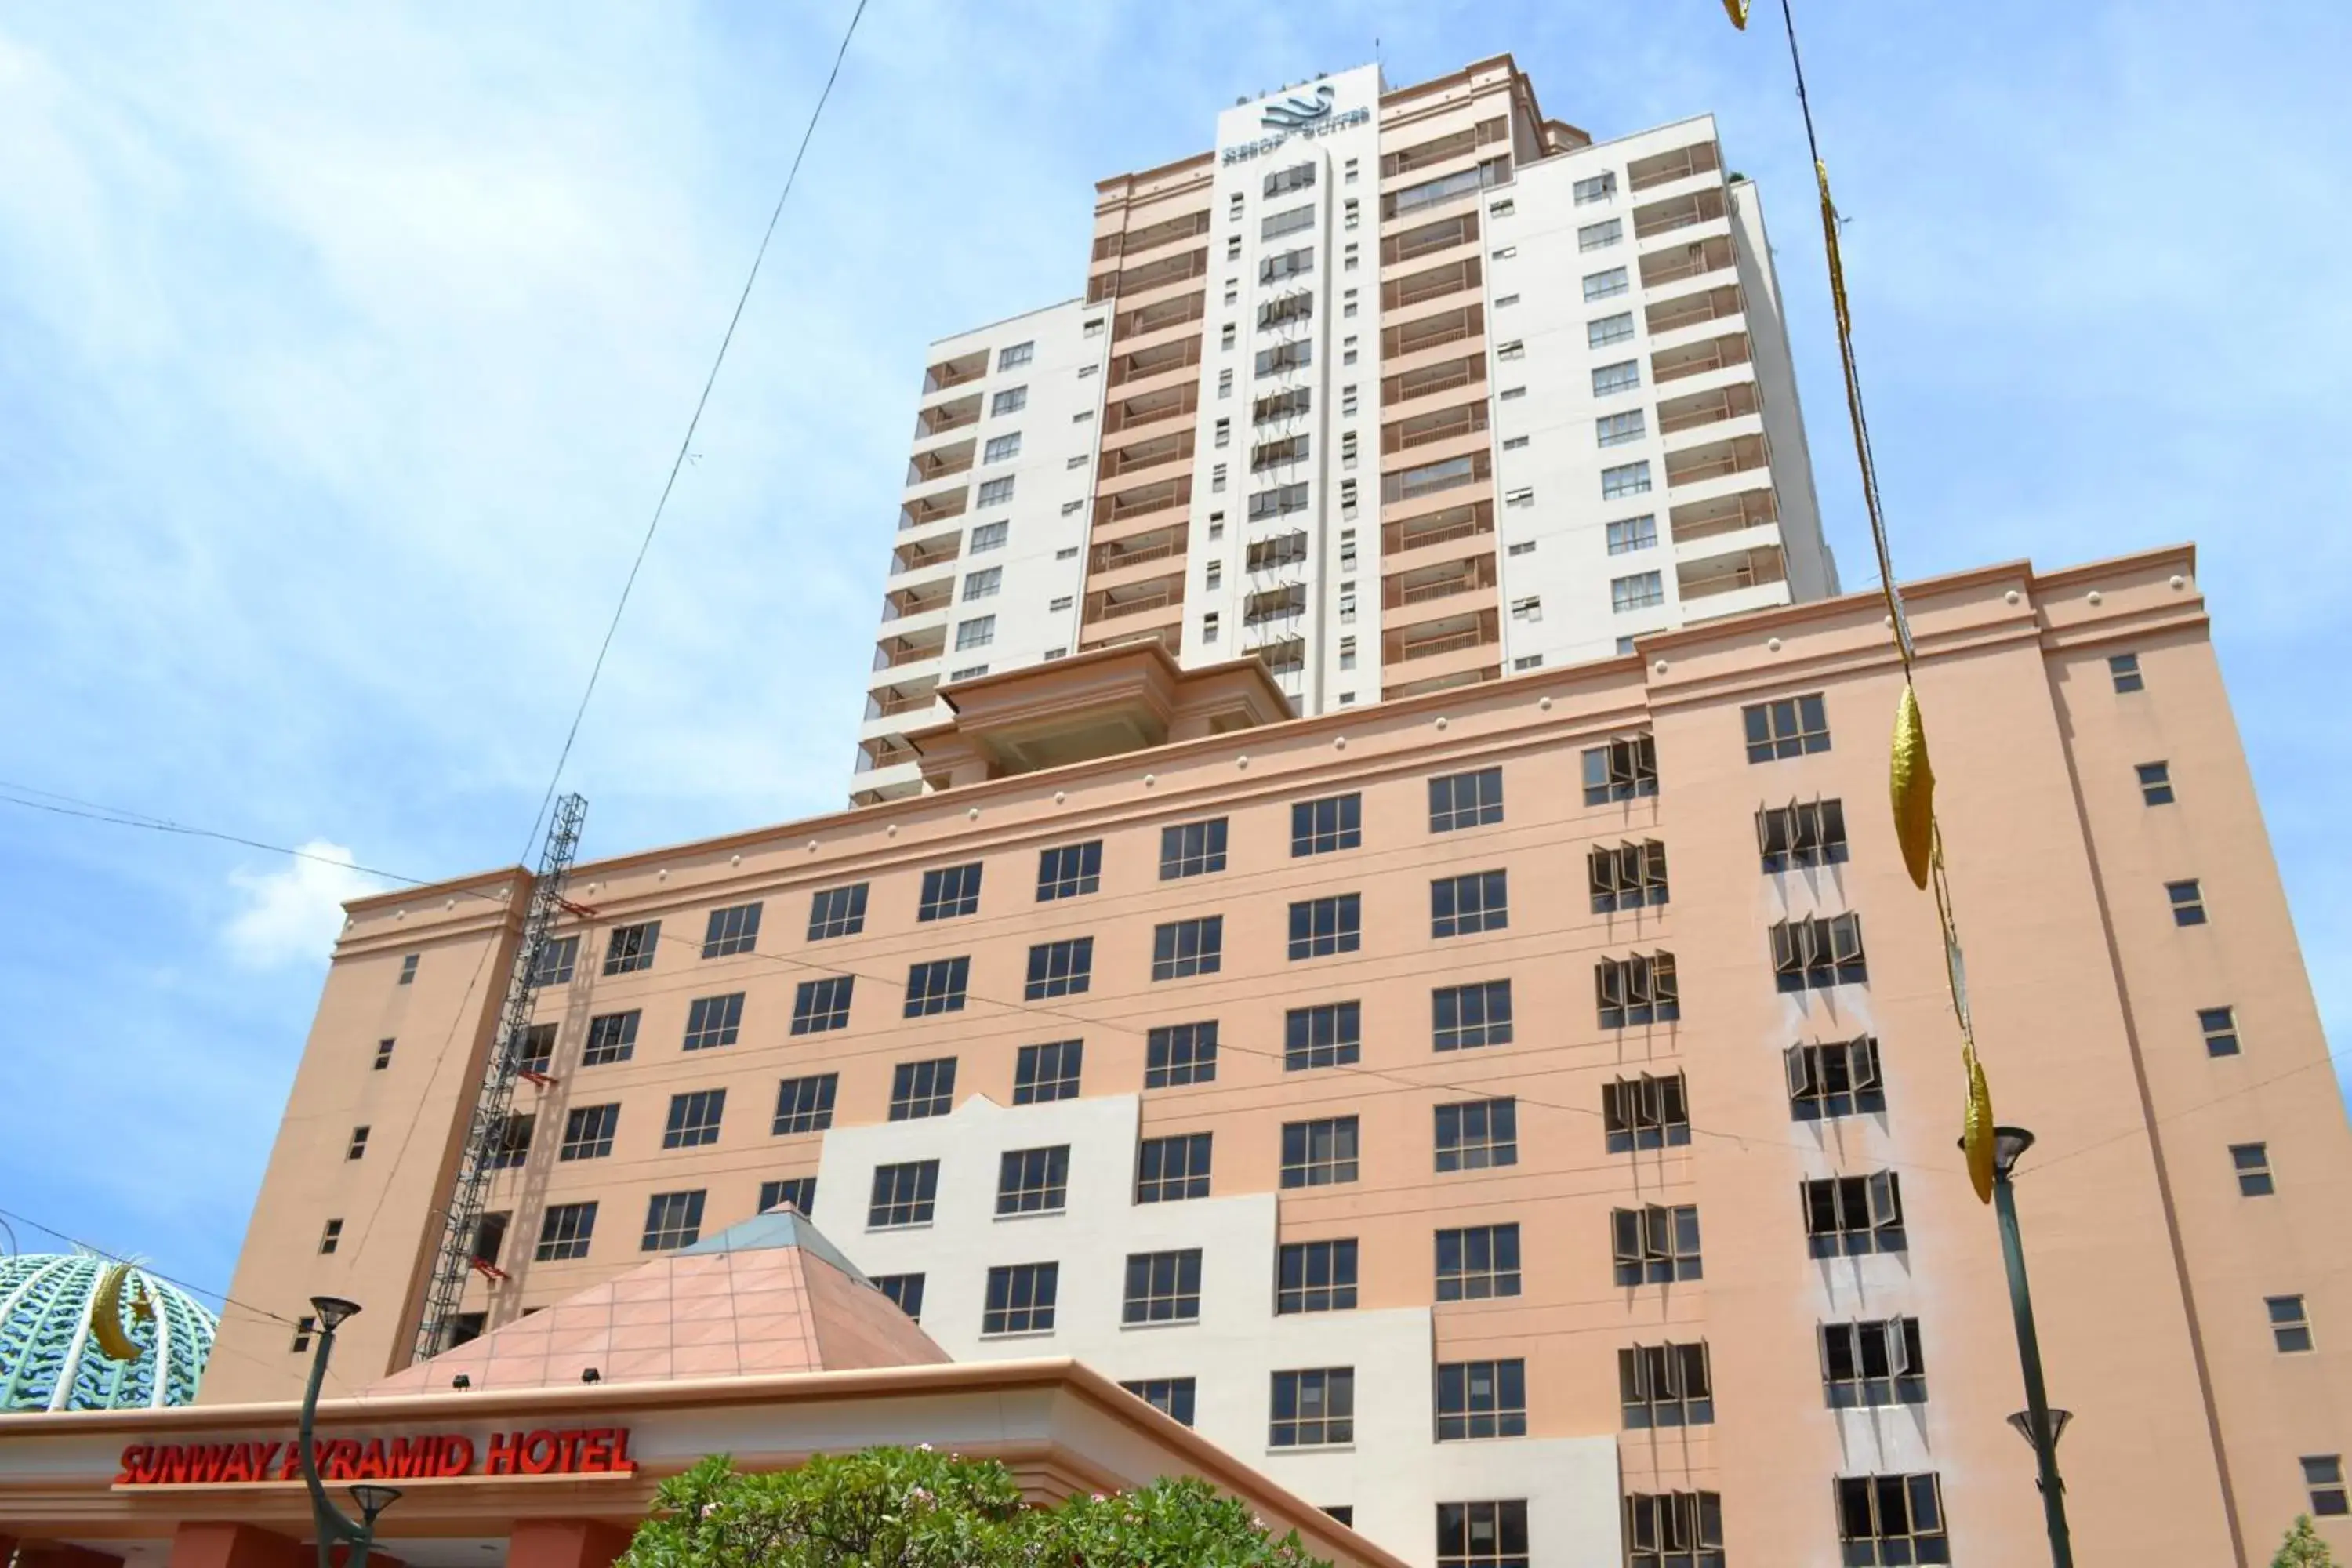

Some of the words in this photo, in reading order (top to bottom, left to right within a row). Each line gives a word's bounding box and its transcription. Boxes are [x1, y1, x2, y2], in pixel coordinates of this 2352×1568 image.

[114, 1441, 281, 1483] SUNWAY
[278, 1434, 474, 1481] PYRAMID
[485, 1427, 639, 1475] HOTEL
